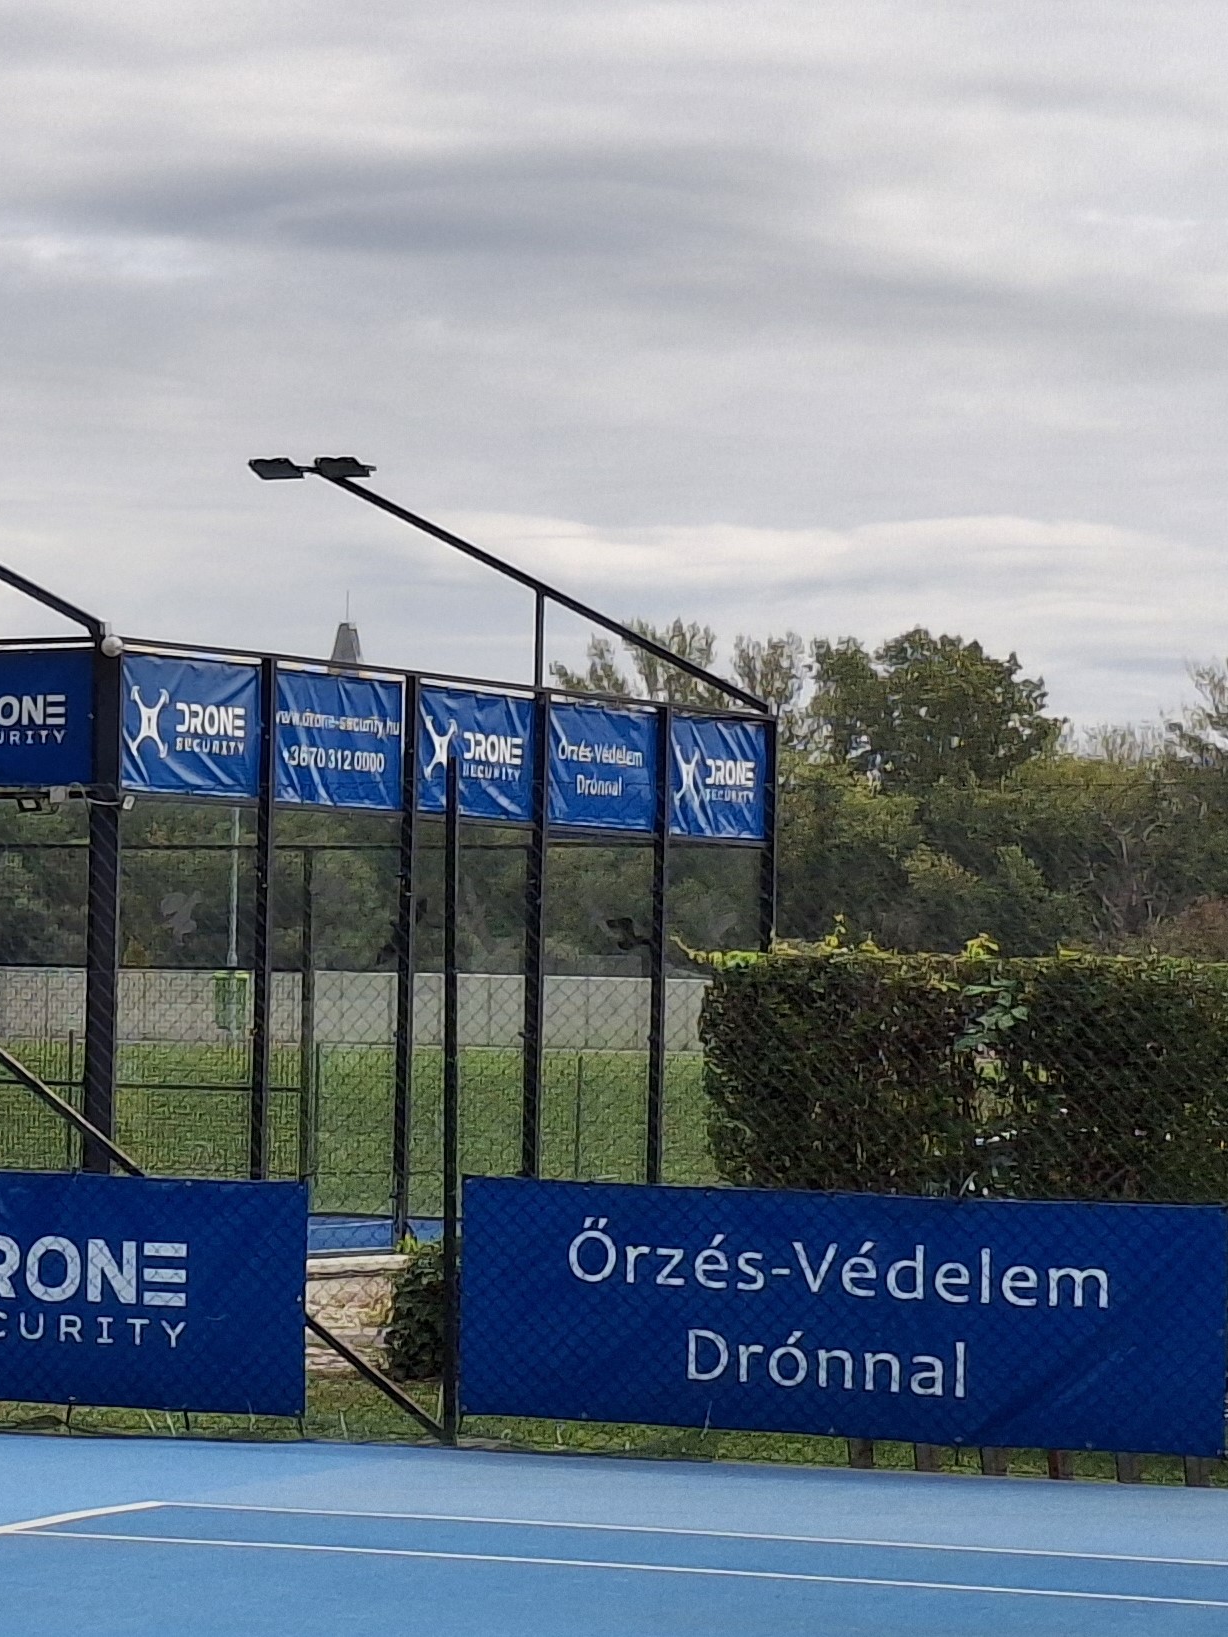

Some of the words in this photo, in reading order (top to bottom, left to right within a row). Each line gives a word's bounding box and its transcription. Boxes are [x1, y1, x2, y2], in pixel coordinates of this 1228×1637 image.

[175, 702, 246, 738] DRONE
[175, 737, 245, 756] SECURITY
[463, 731, 523, 765] DRONE
[705, 758, 755, 788] DRONE
[568, 1217, 1111, 1309] Őrzés-Védelem
[687, 1328, 967, 1399] Drónnal
